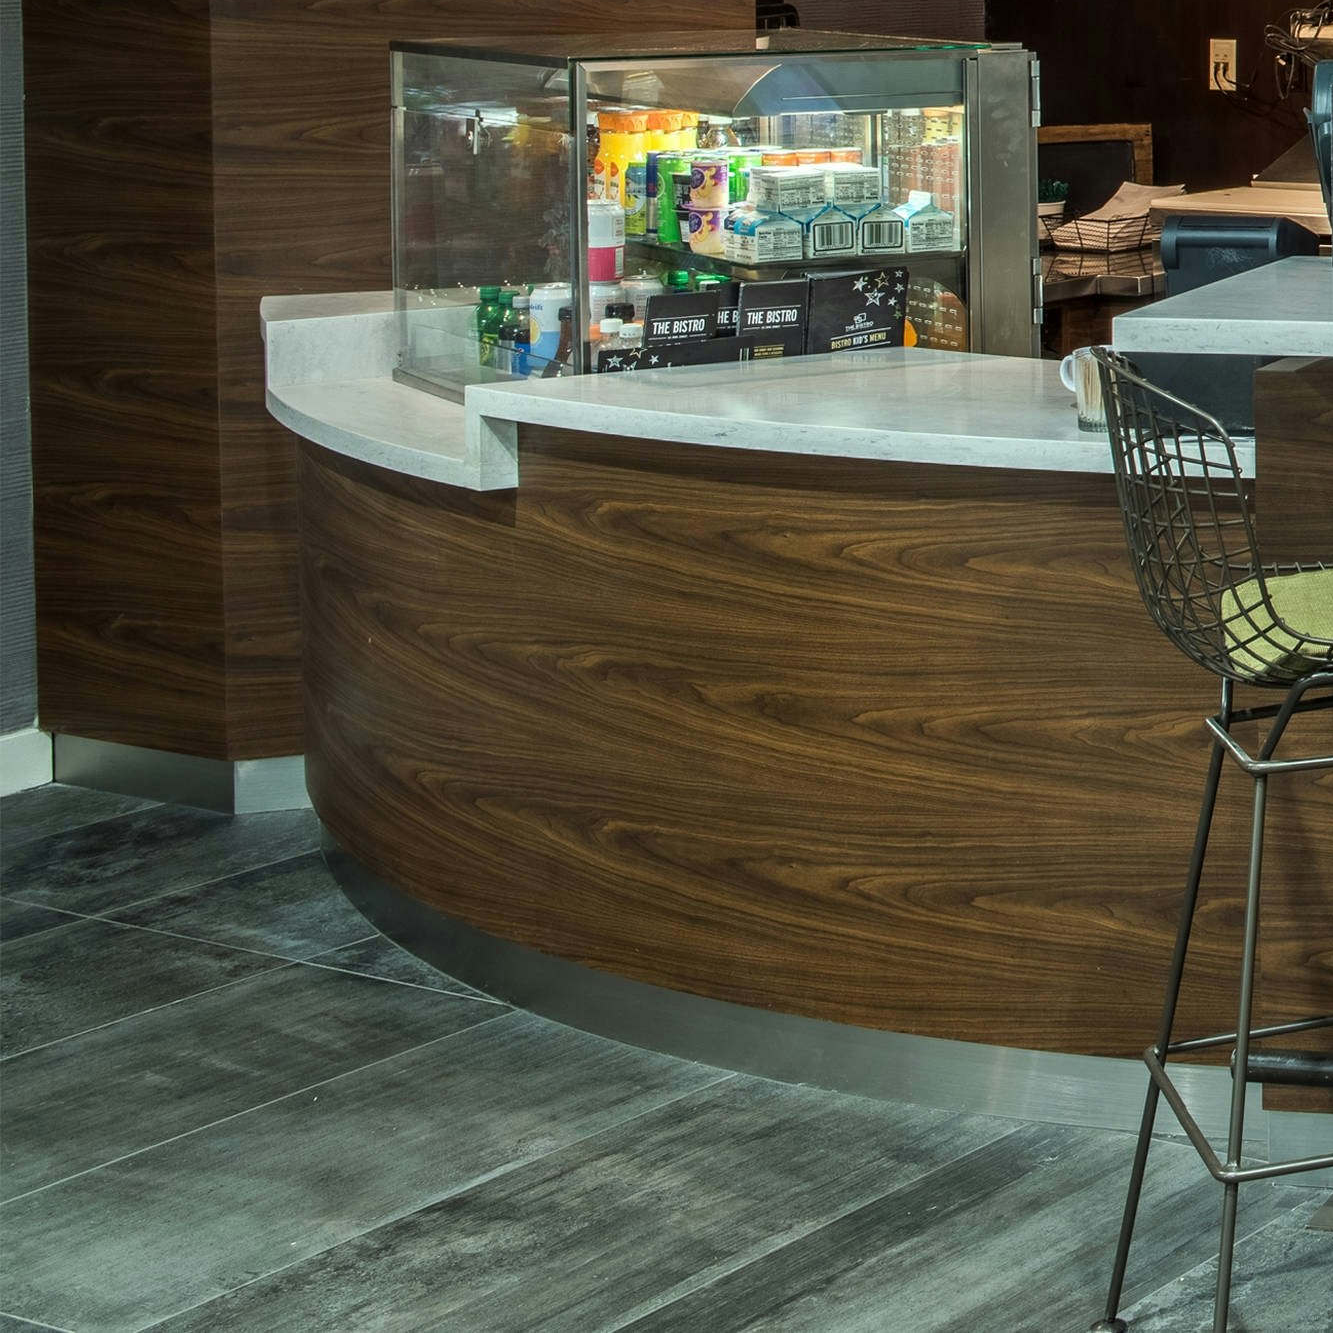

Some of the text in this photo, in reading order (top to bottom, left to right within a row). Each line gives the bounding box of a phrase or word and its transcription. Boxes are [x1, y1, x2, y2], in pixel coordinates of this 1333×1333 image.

[747, 308, 798, 325] THE BISTRO
[653, 319, 705, 335] THE BISTRO
[830, 331, 887, 350] BISTRO KID'S MENU
